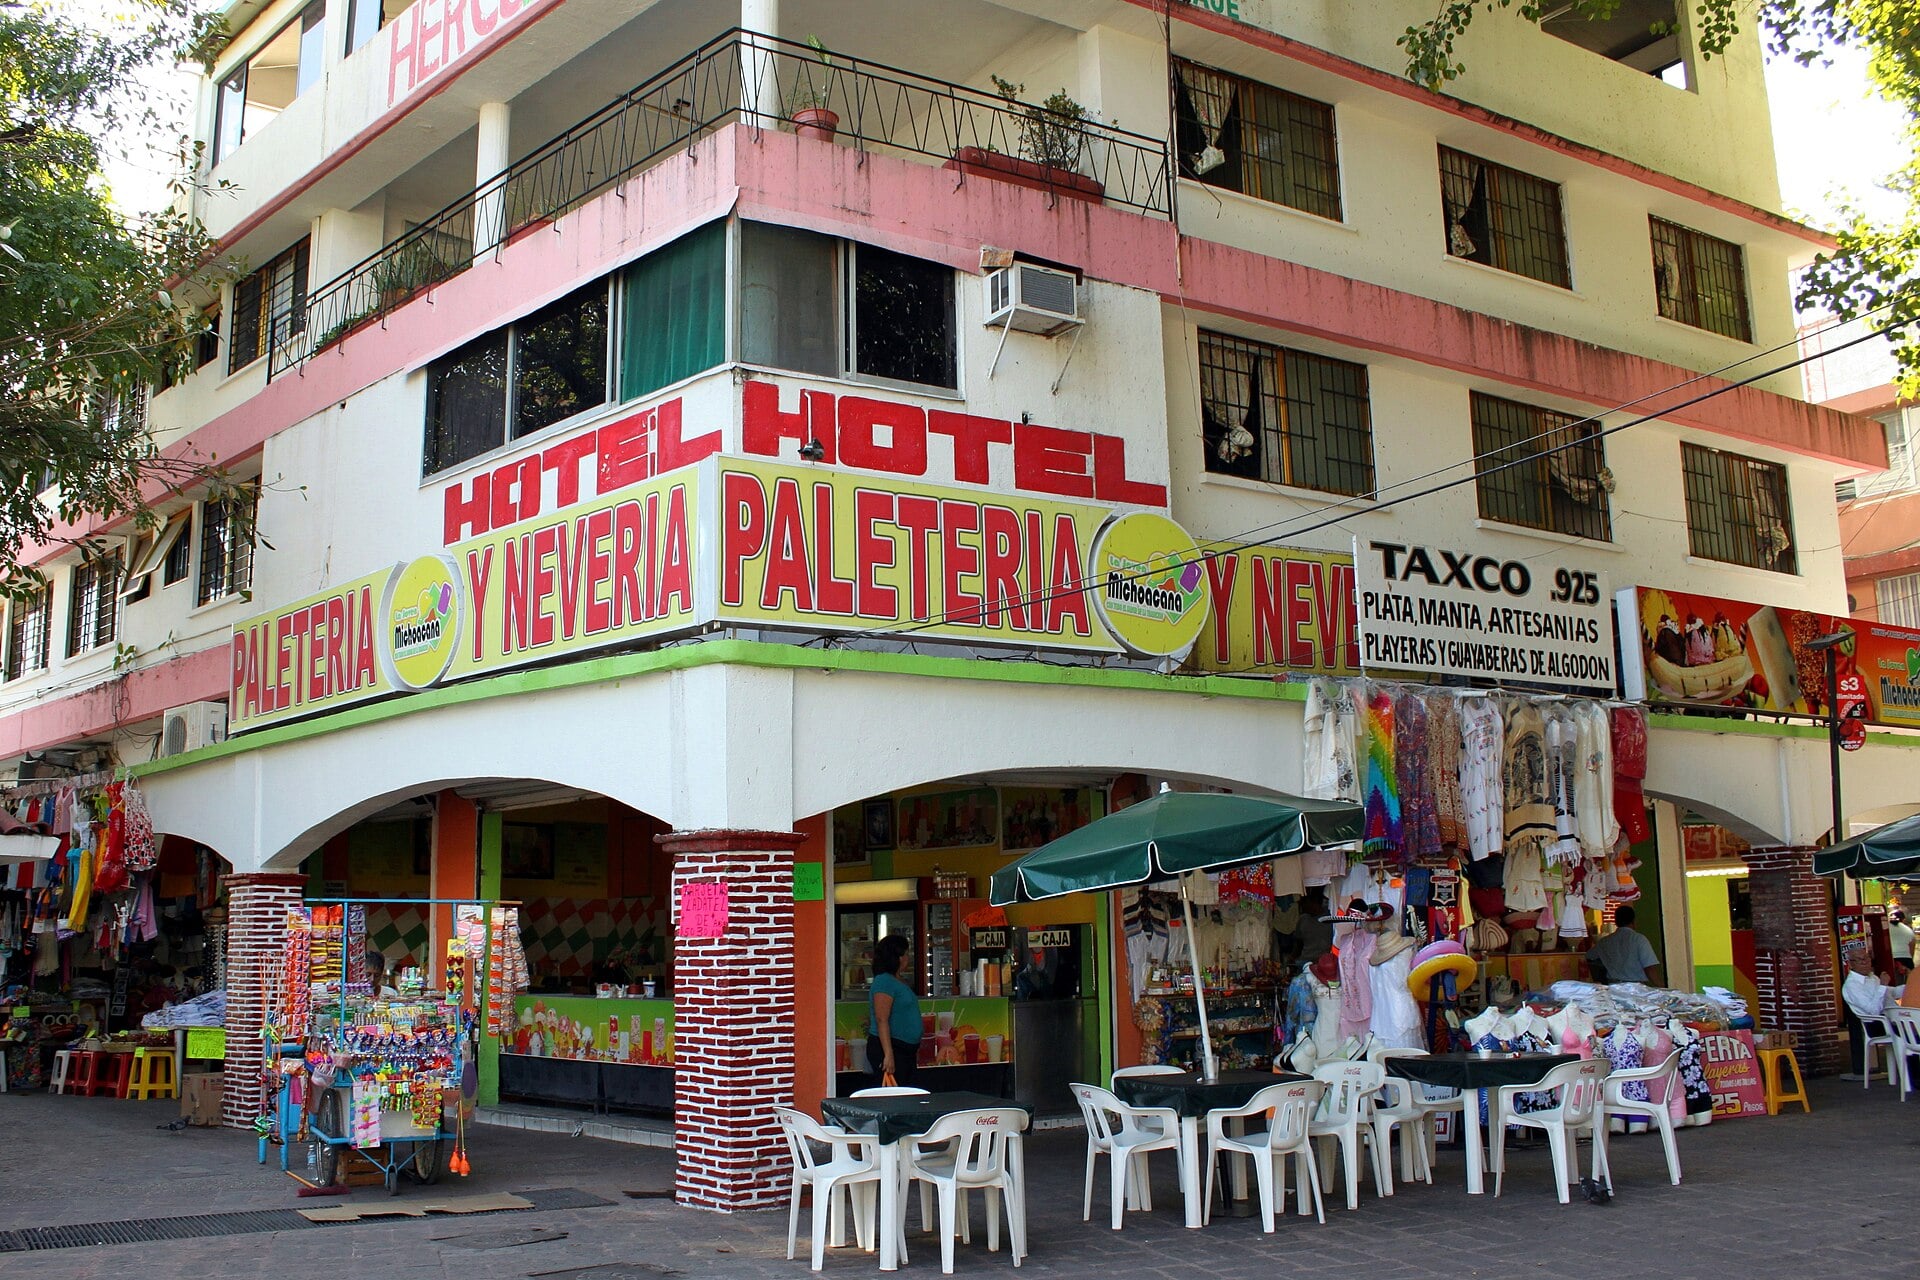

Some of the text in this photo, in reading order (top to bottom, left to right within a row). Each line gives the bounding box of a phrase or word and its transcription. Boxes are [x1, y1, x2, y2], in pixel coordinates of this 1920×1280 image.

[387, 0, 526, 108] HER
[443, 397, 722, 547] HOTEL
[743, 380, 1167, 508] HOTEL
[466, 484, 694, 663] Y NEVERIA
[720, 471, 1093, 638] PALETERIA
[1370, 540, 1600, 605] TAXCO .925
[1107, 571, 1183, 613] Michoacana
[1202, 551, 1240, 665] Y
[1362, 591, 1599, 644] PLATA, MANTA, ARTESANIAS
[231, 584, 378, 724] PALETERIA
[395, 620, 441, 649] Michoacana
[1365, 632, 1610, 682] PLAYERAS Y GUAYABERAS DE ALGODON
[1880, 676, 1920, 706] Michoac
[985, 933, 1005, 947] CAJA
[1041, 931, 1070, 947] CAJA
